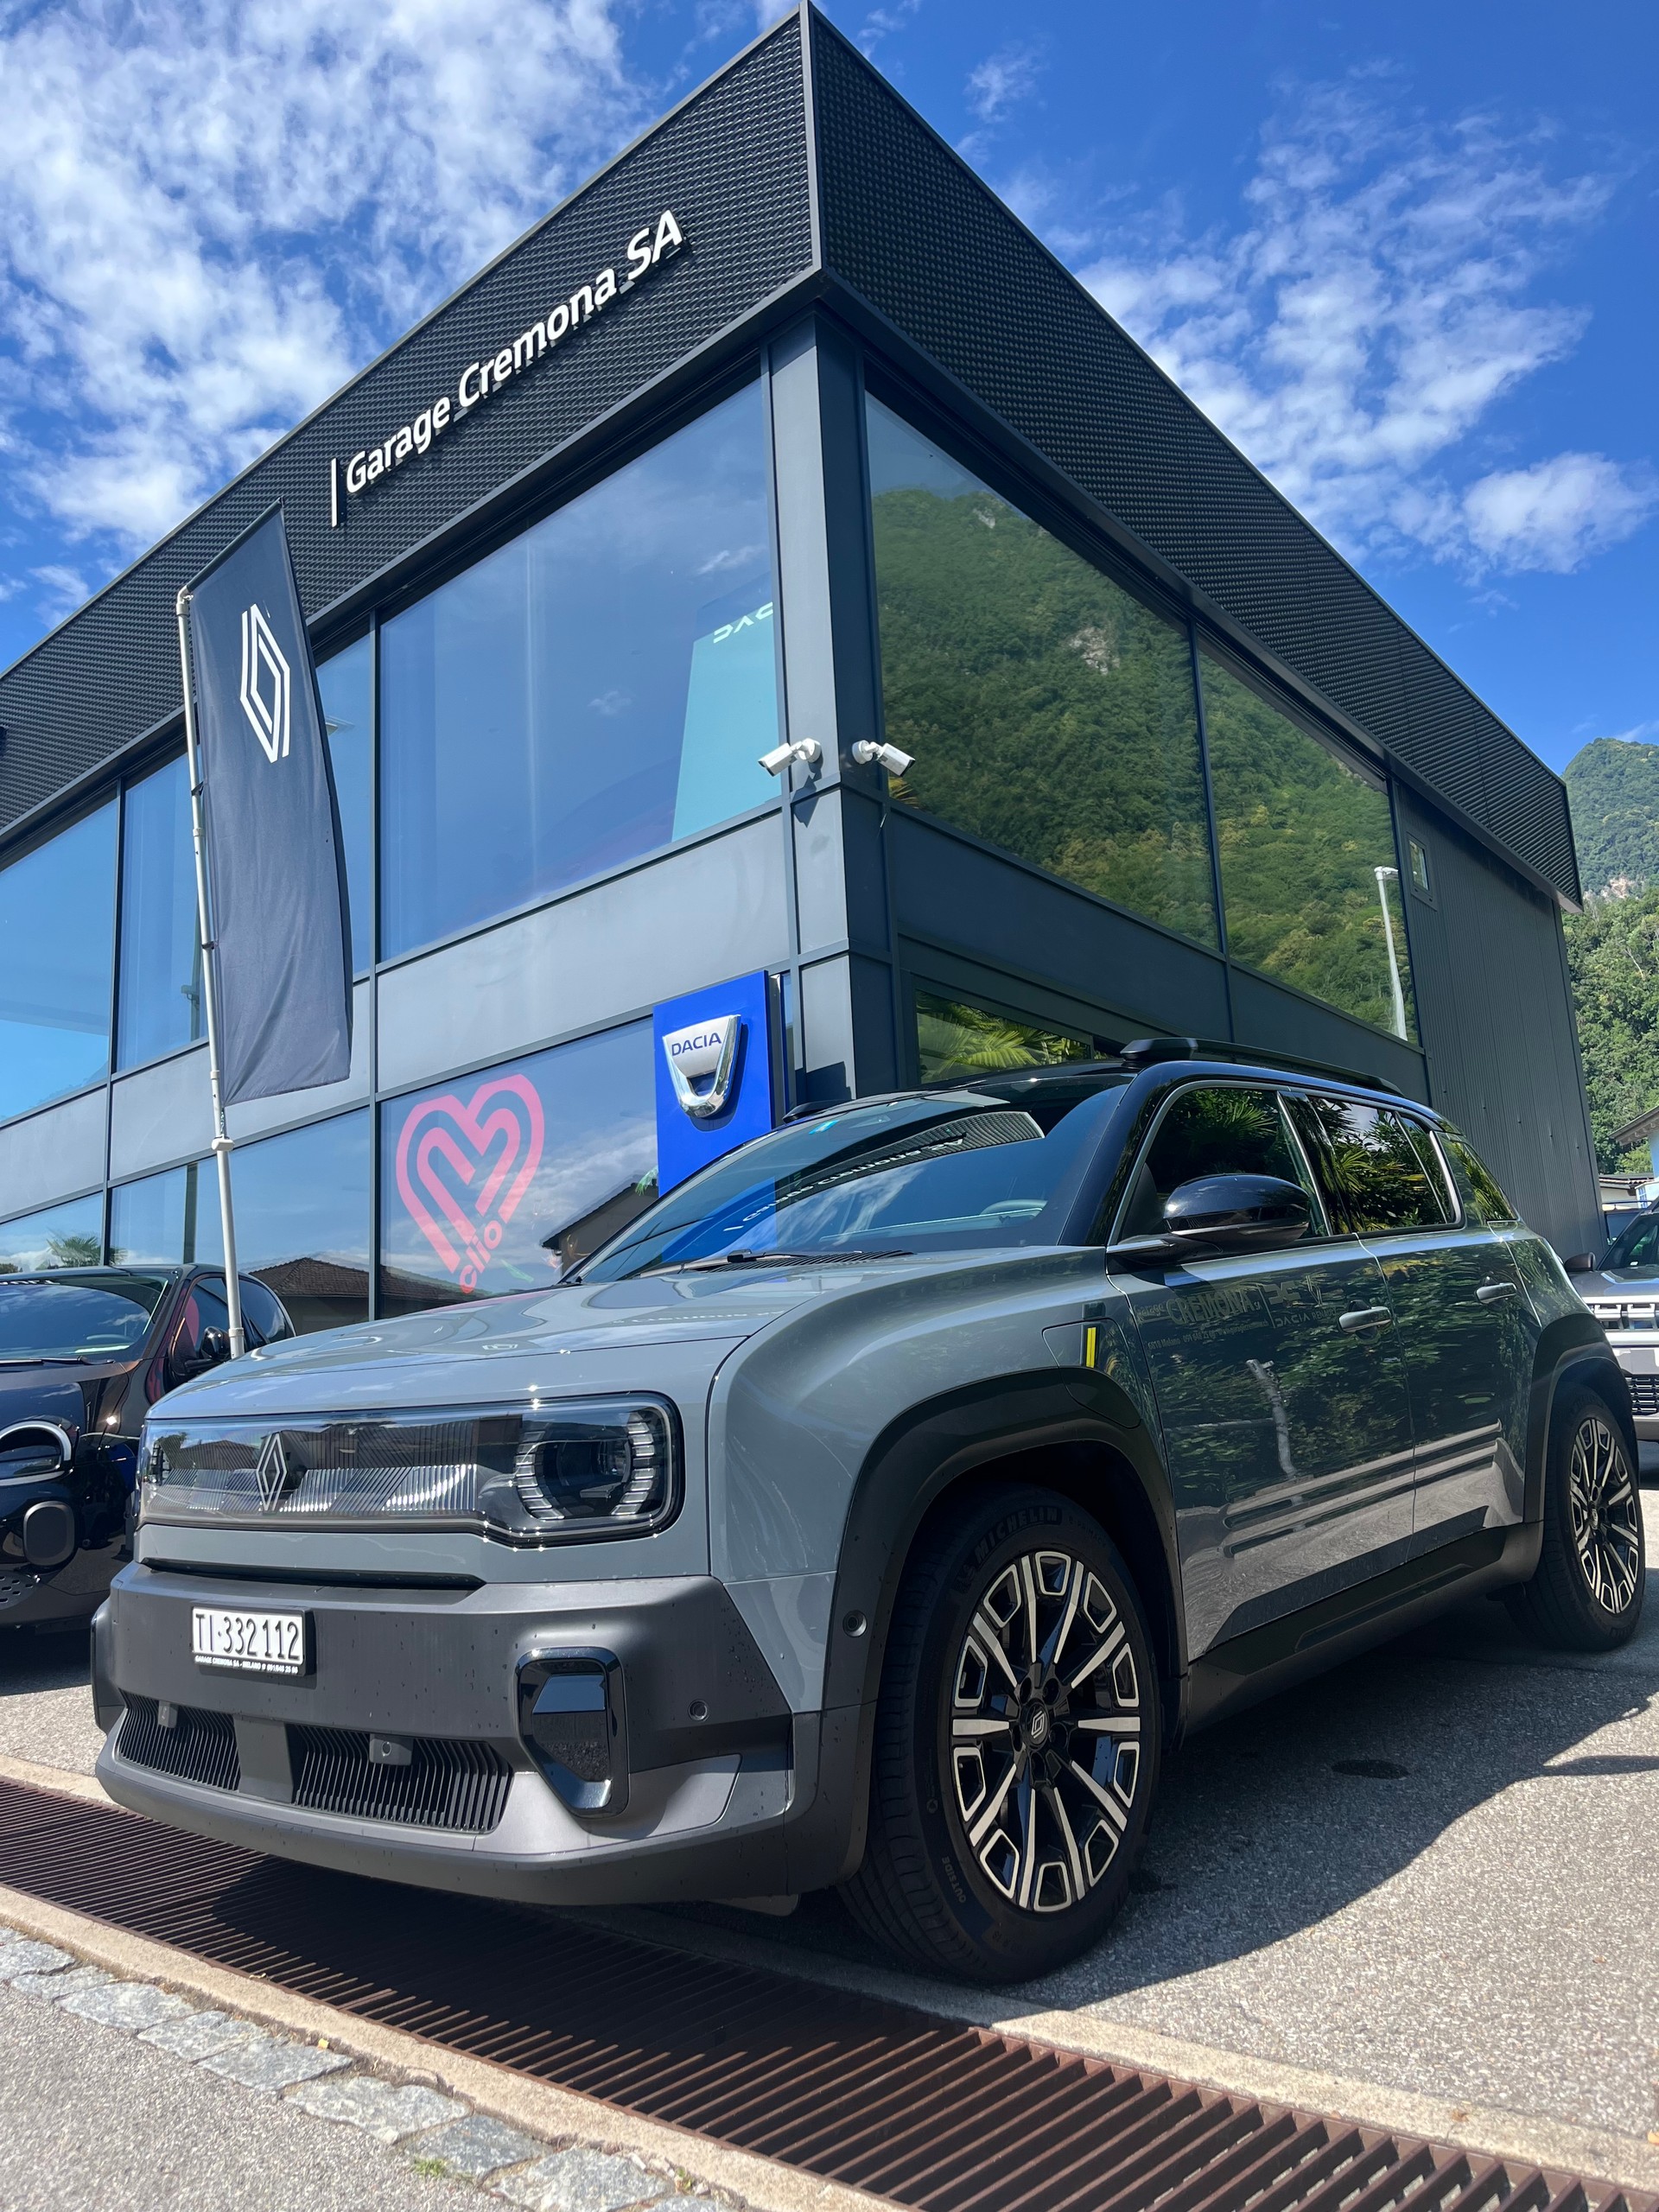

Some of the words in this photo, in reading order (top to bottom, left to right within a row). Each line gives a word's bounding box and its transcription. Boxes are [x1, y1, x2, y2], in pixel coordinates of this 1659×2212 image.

[346, 397, 451, 493] Garage
[458, 268, 618, 407] Cremona
[626, 210, 683, 279] SA
[671, 1032, 721, 1056] DACIA
[459, 1220, 503, 1294] clio
[1166, 1289, 1255, 1325] CREMONA
[1274, 1313, 1311, 1327] DACIA
[974, 1507, 1058, 1563] MICHELIN
[943, 1856, 966, 1903] OUTSIDE
